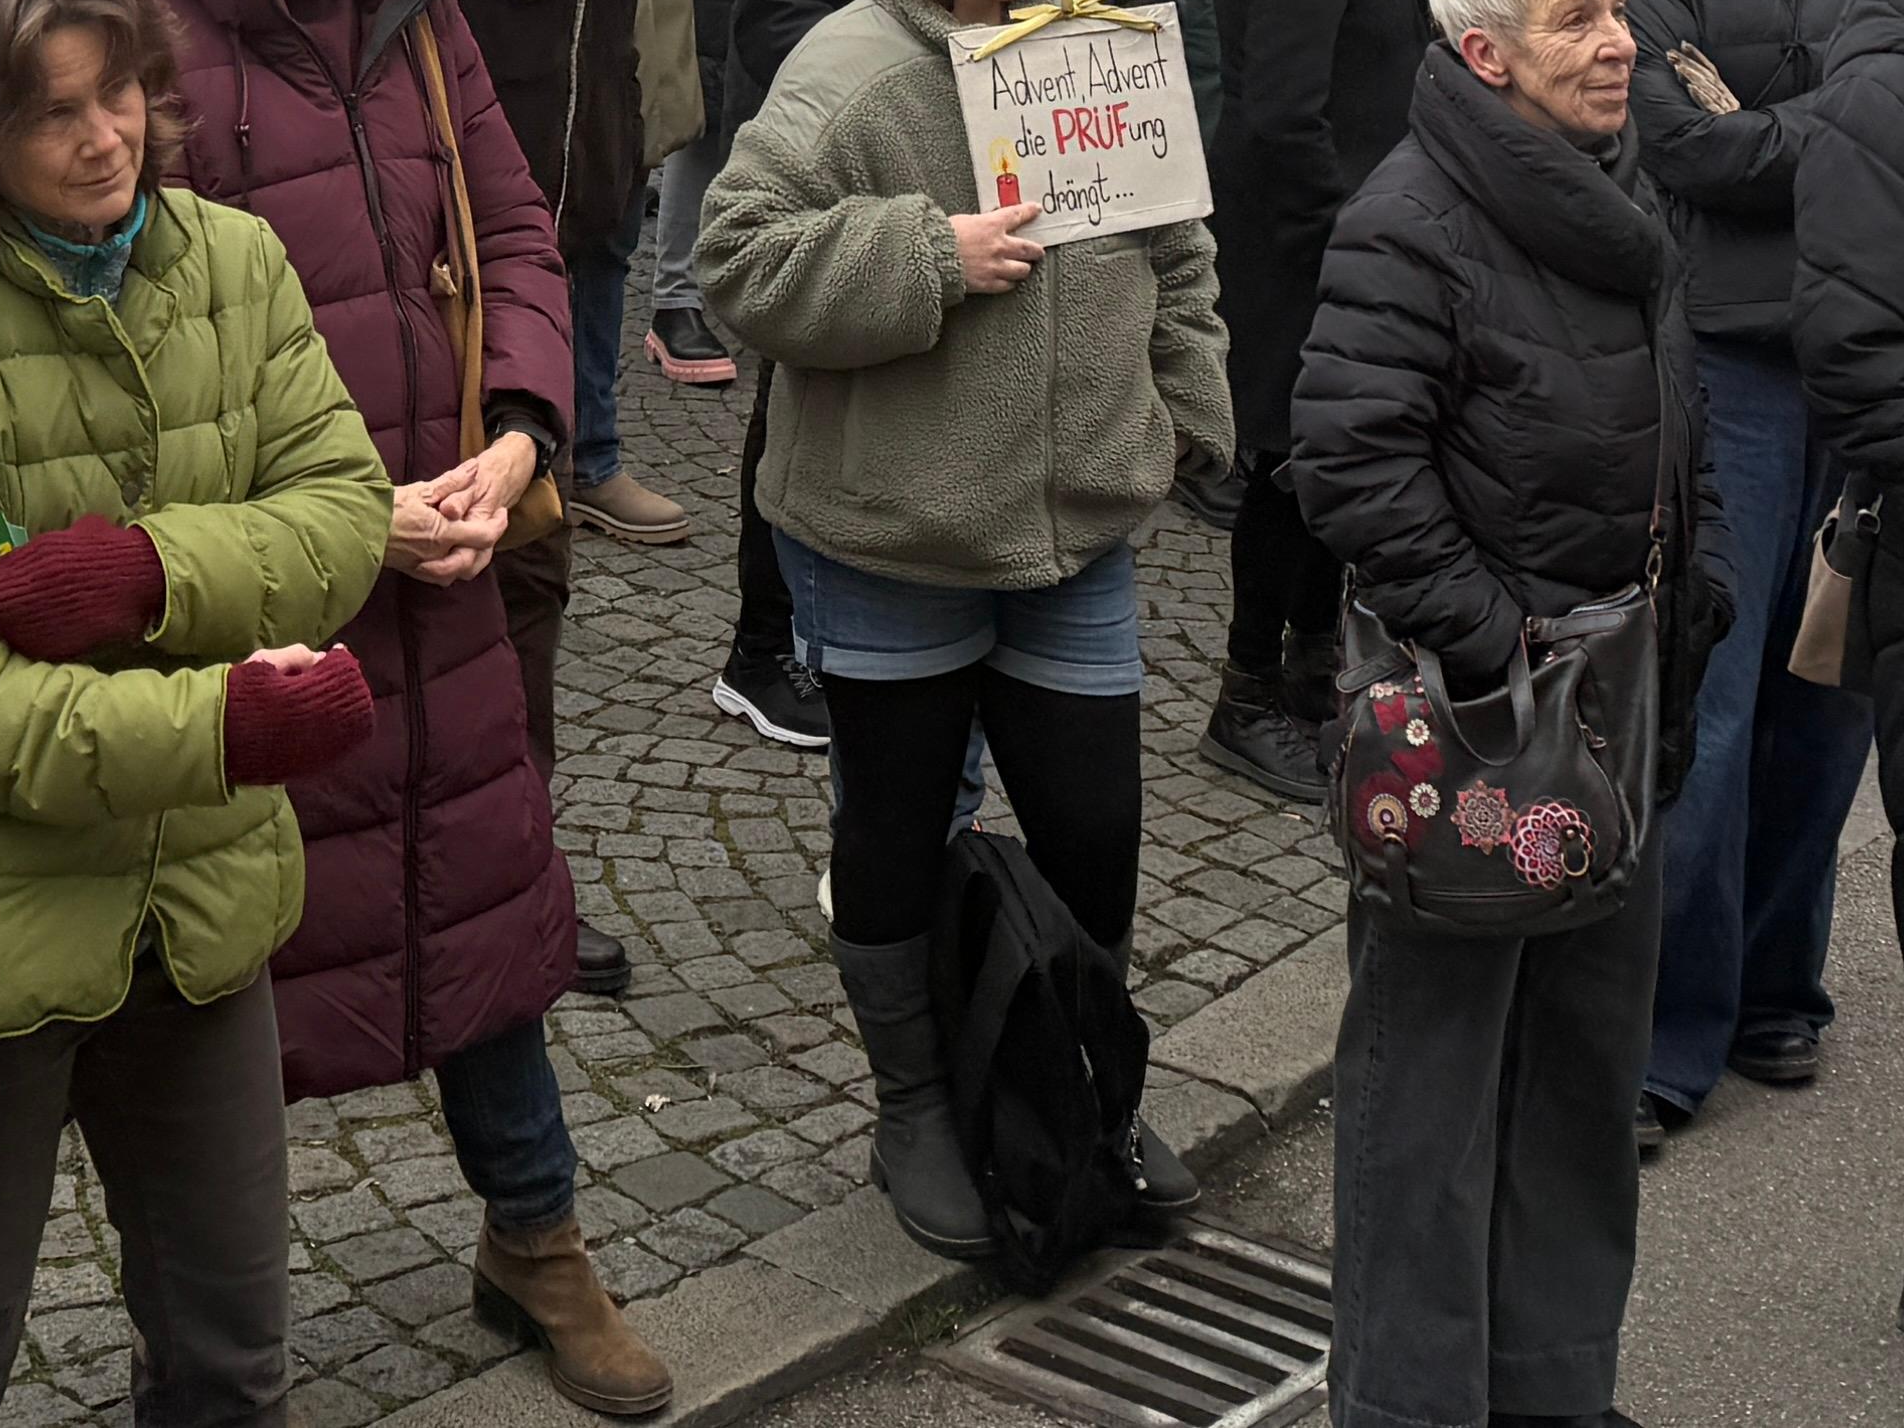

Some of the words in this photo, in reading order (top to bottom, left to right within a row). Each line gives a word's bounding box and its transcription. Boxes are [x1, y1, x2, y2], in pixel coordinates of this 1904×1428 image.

[991, 45, 1086, 110] Advent,
[1089, 29, 1168, 97] Advent
[1014, 114, 1047, 159] die
[1051, 101, 1168, 159] PRÜFung
[1041, 162, 1134, 226] drängt...
